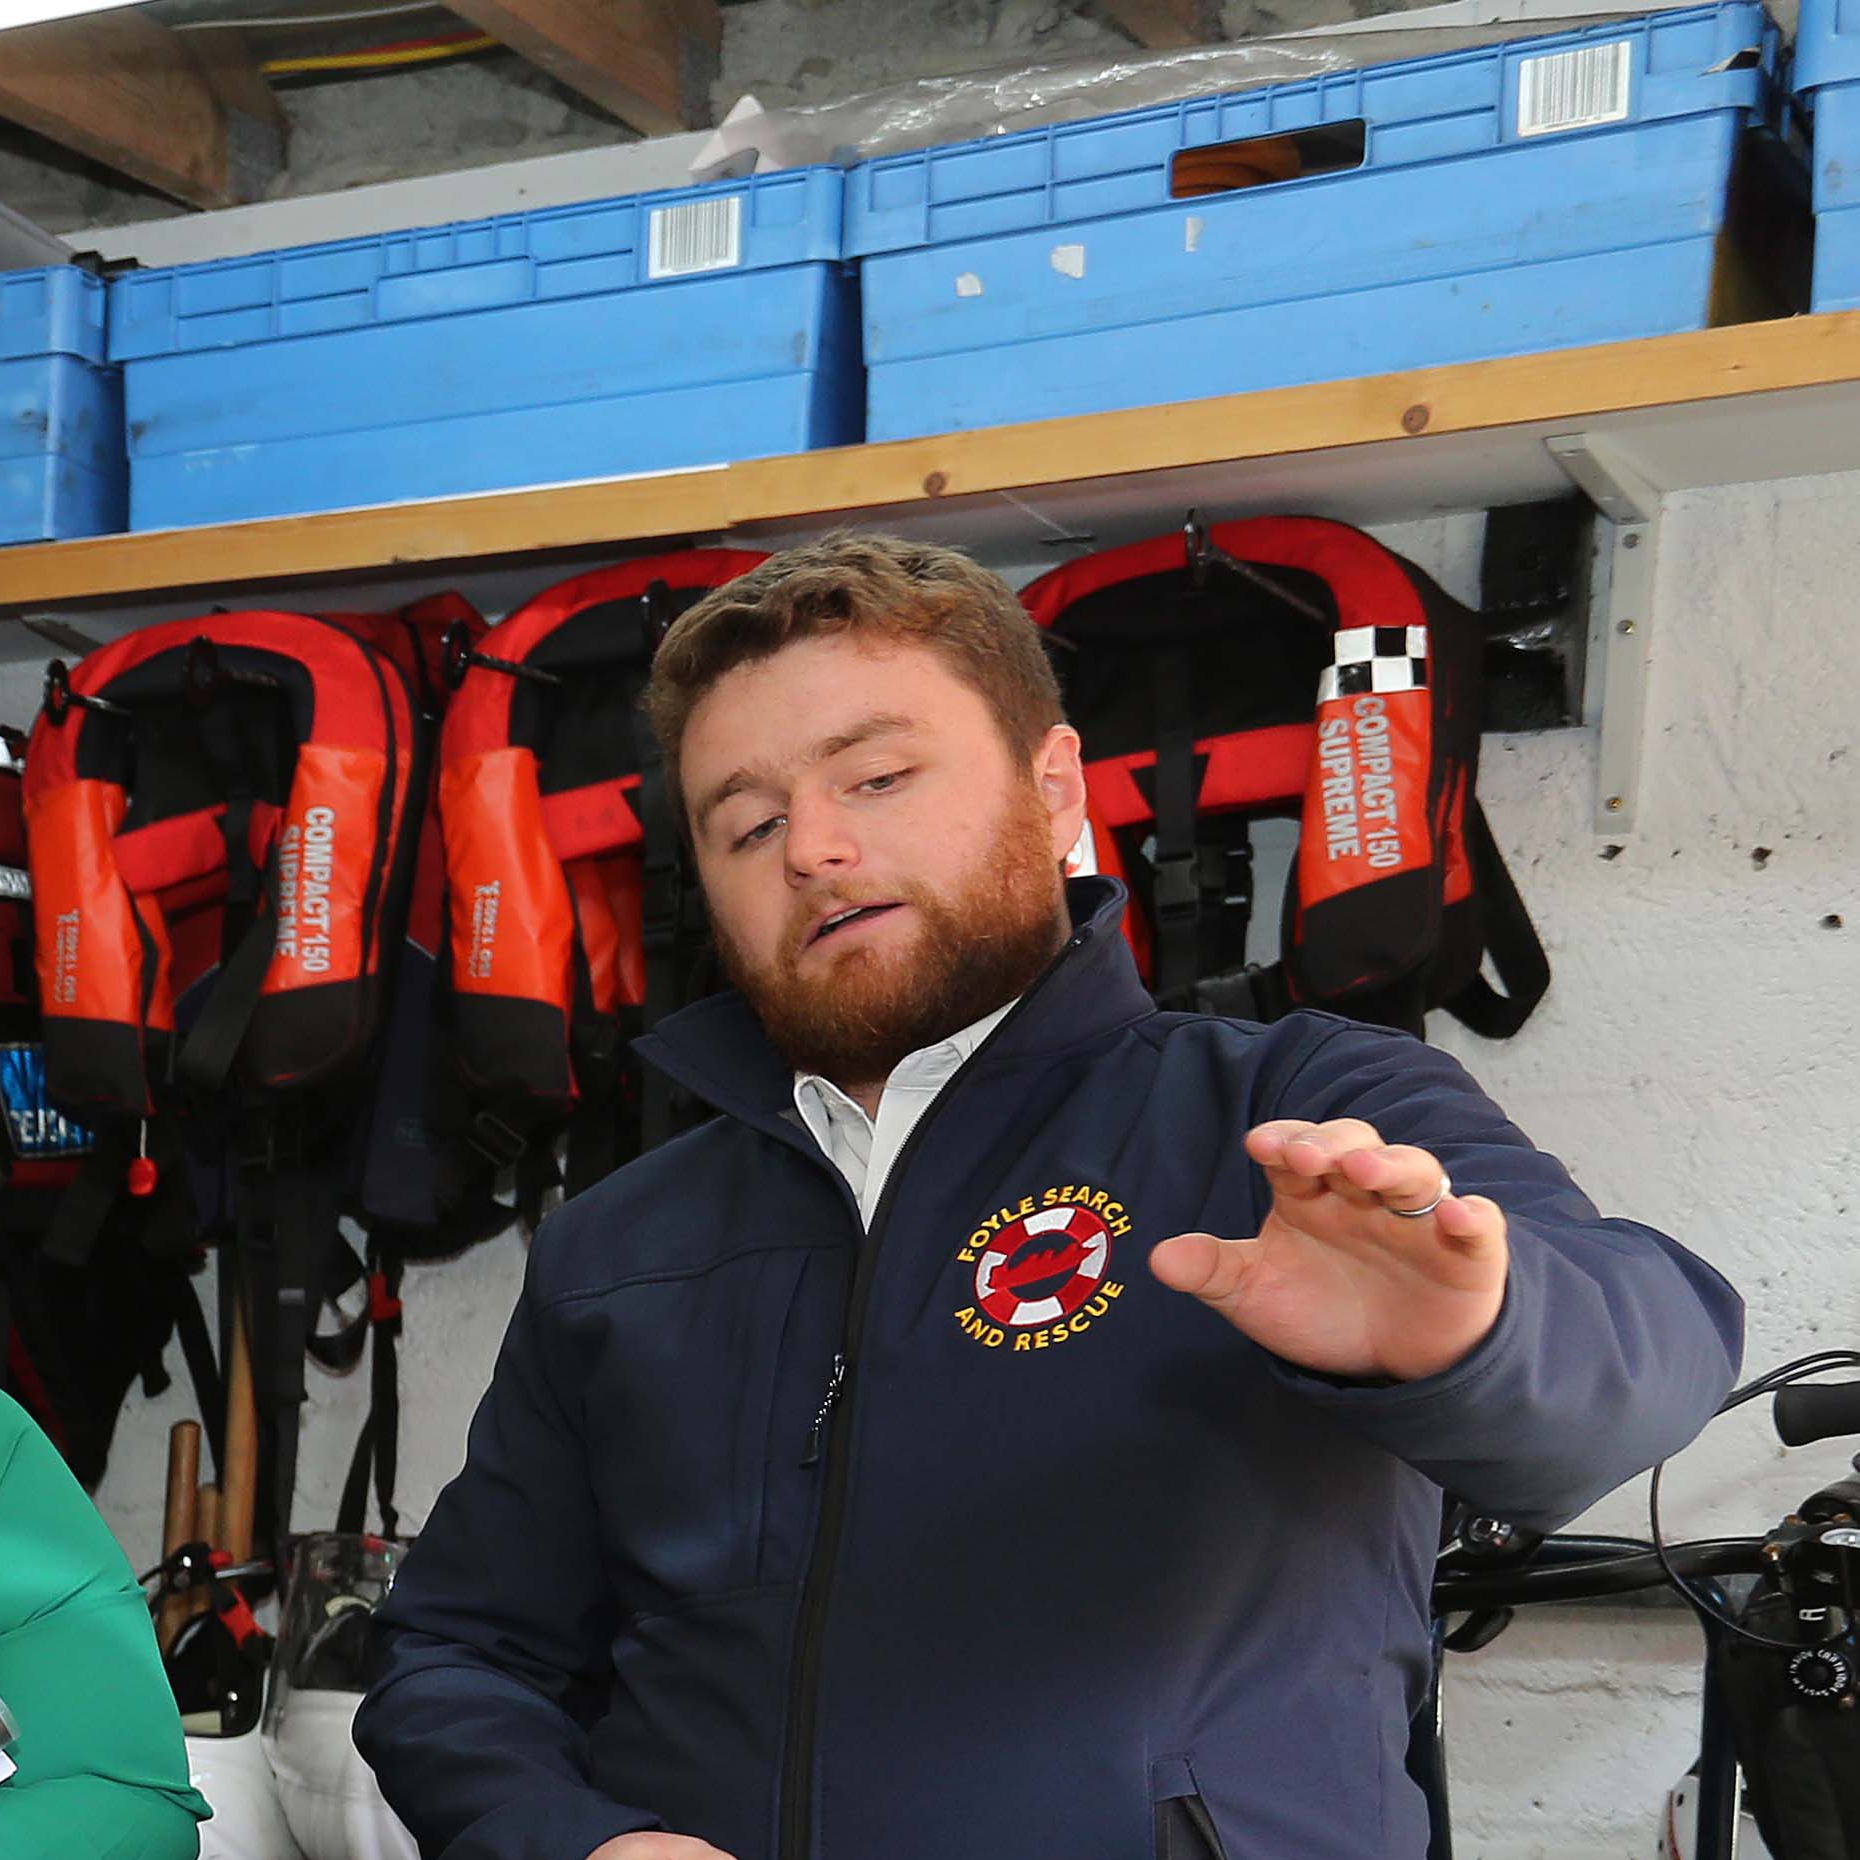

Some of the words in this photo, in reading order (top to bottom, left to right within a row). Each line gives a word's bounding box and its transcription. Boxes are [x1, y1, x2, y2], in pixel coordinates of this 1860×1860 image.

[1318, 719, 1360, 861] SUPREME
[1353, 697, 1398, 824] COMPACT
[277, 824, 301, 958] SUPREME
[302, 806, 335, 933] COMPACT
[1366, 827, 1402, 868] 150
[302, 934, 330, 973] 150
[957, 1196, 1036, 1263] FOYLE
[1042, 1185, 1132, 1237] SEARCH
[954, 1306, 1006, 1348] AND
[1014, 1280, 1124, 1351] RESCUE
